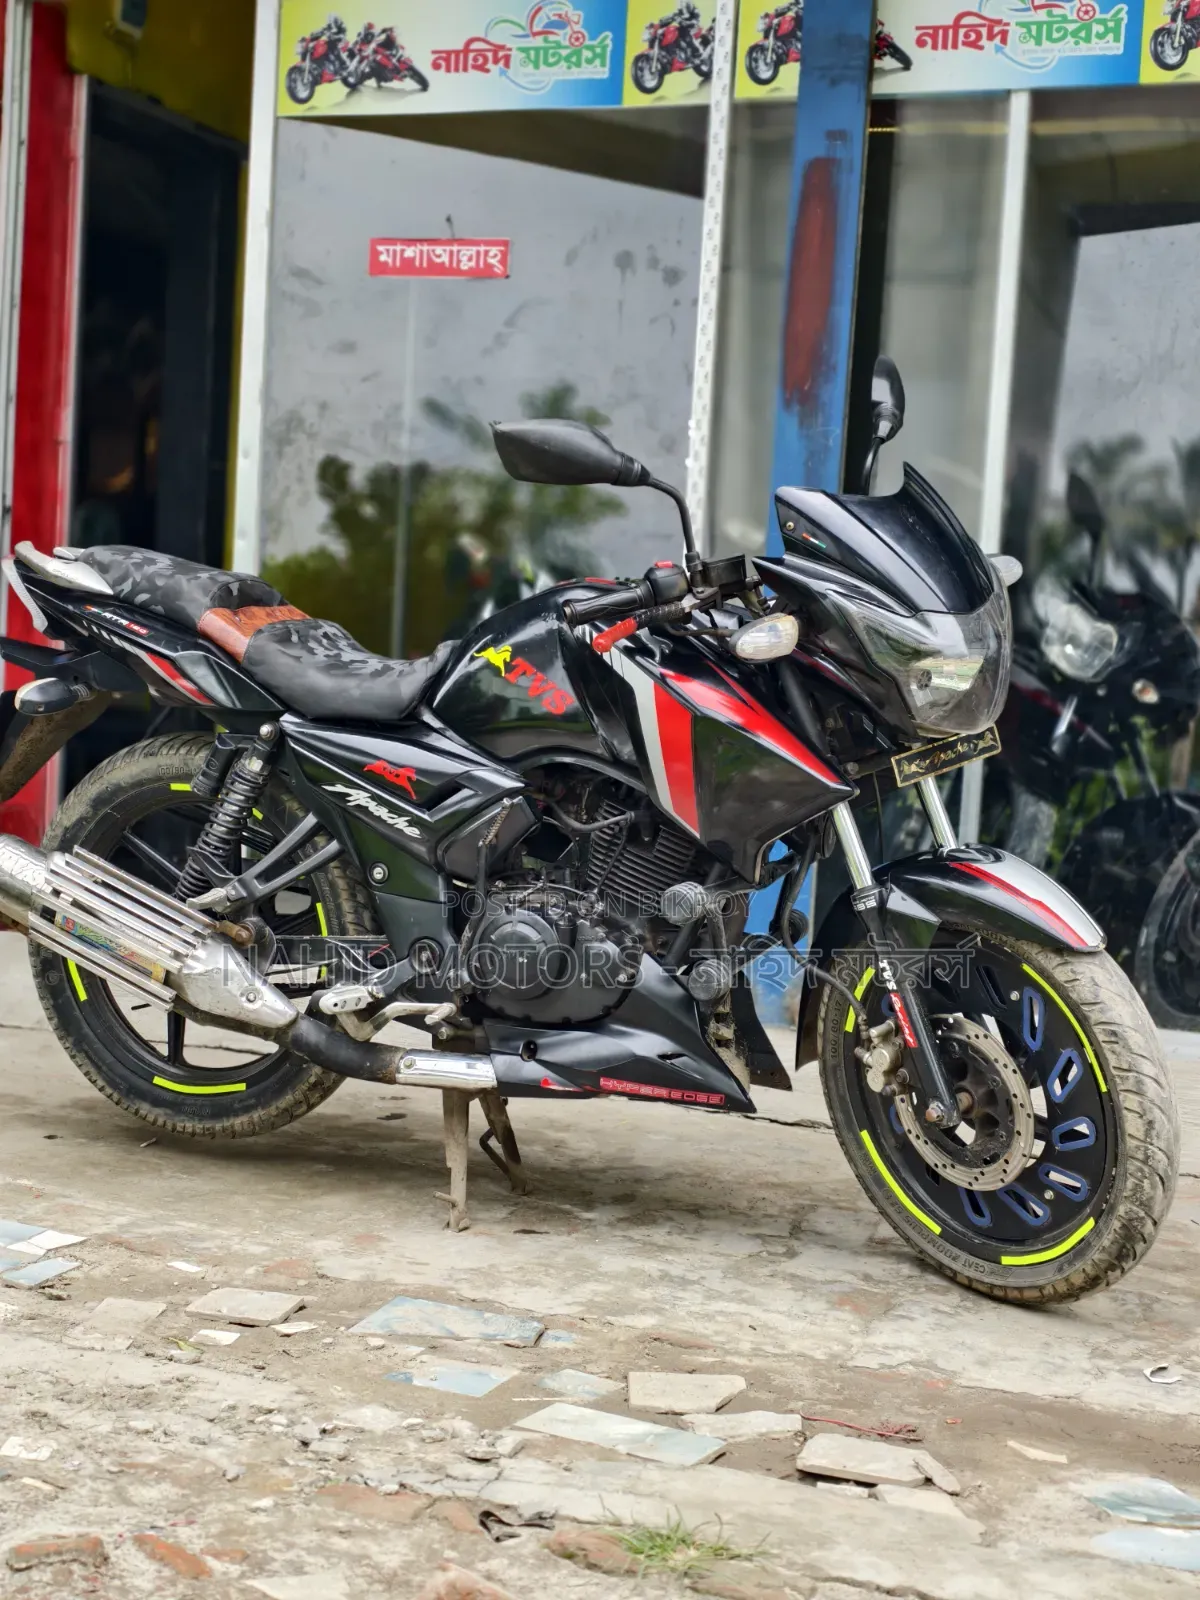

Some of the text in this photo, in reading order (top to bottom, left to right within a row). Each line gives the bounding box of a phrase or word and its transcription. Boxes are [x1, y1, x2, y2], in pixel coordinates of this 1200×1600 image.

[915, 11, 1010, 51] নাহিদ
[431, 36, 513, 74] নাহিদ
[504, 656, 575, 715] TVS
[320, 784, 422, 838] Apache
[878, 959, 897, 991] TVS
[670, 1090, 723, 1105] EDGE
